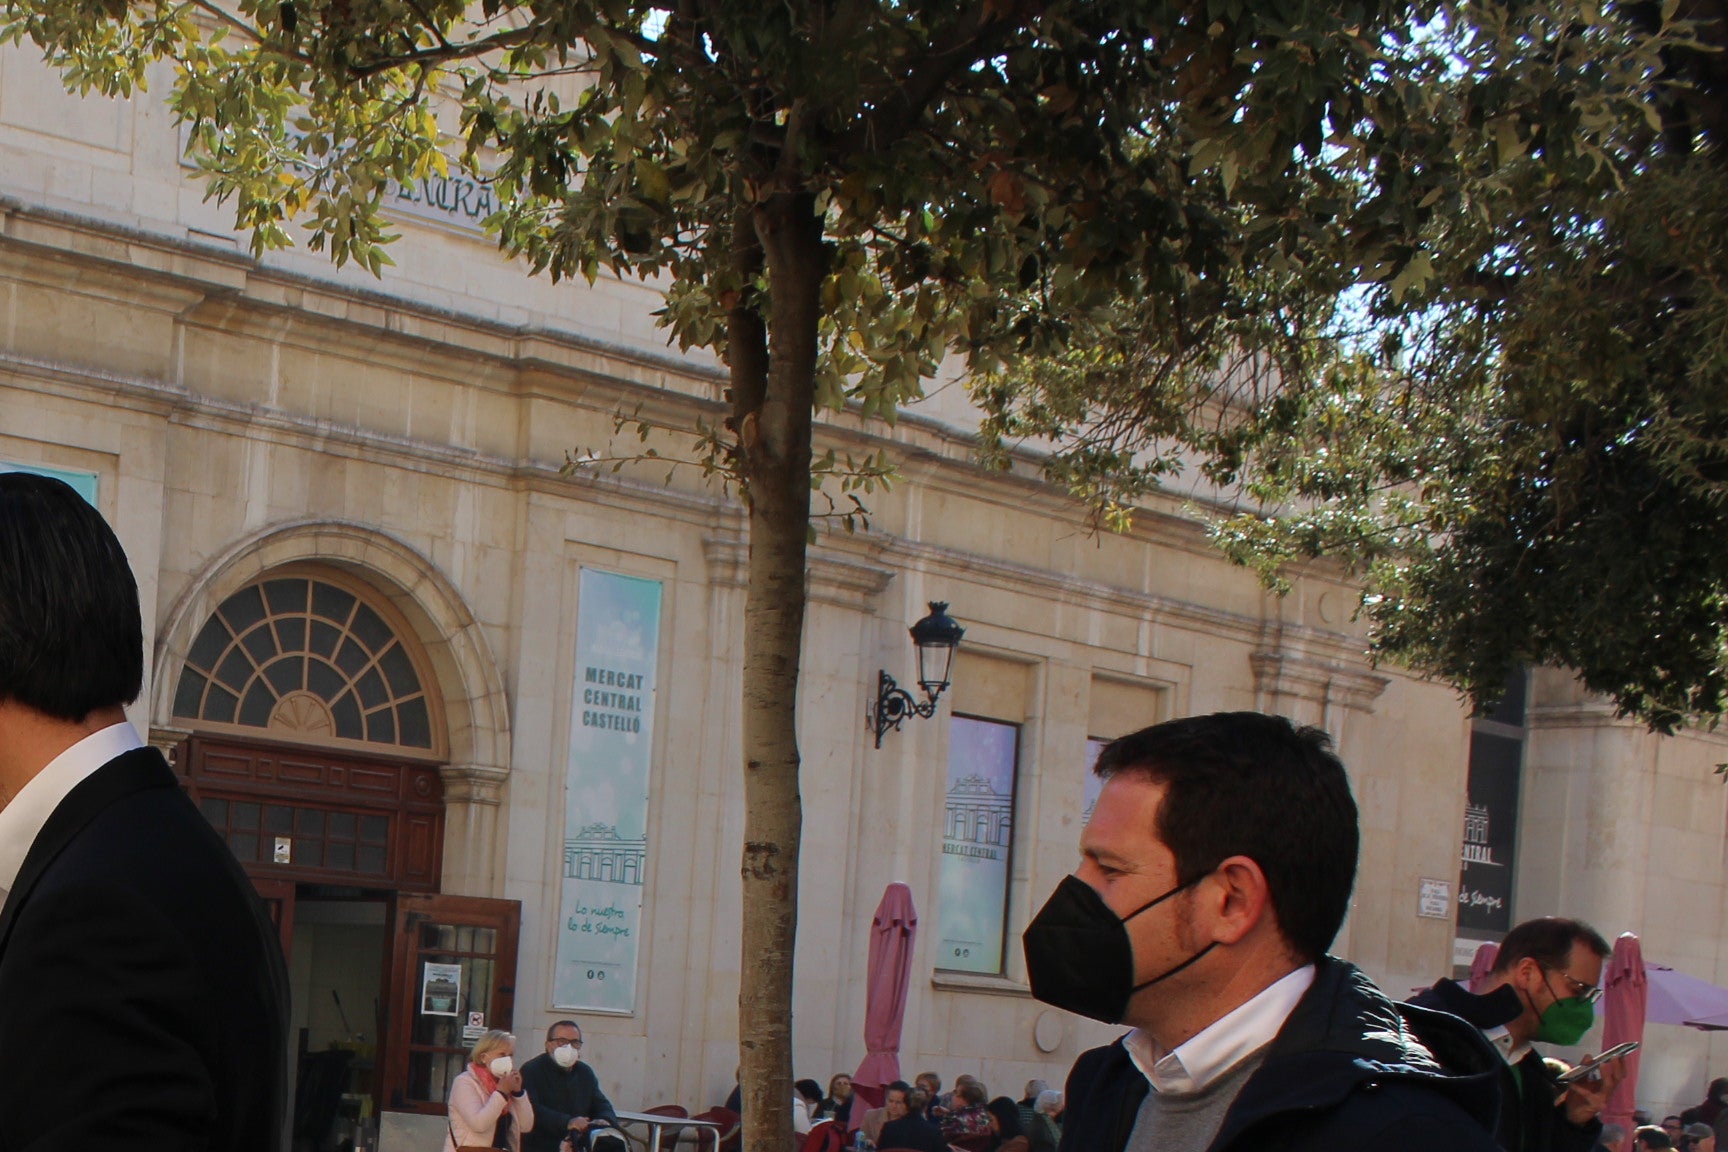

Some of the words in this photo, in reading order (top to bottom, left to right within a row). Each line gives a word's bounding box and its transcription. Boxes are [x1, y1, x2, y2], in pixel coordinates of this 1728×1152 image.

[585, 666, 643, 690] MERCAT
[584, 688, 642, 712] CENTRAL
[582, 710, 641, 734] CASTELLÓ
[575, 899, 587, 915] Lo
[567, 917, 578, 932] lo
[581, 917, 592, 932] de
